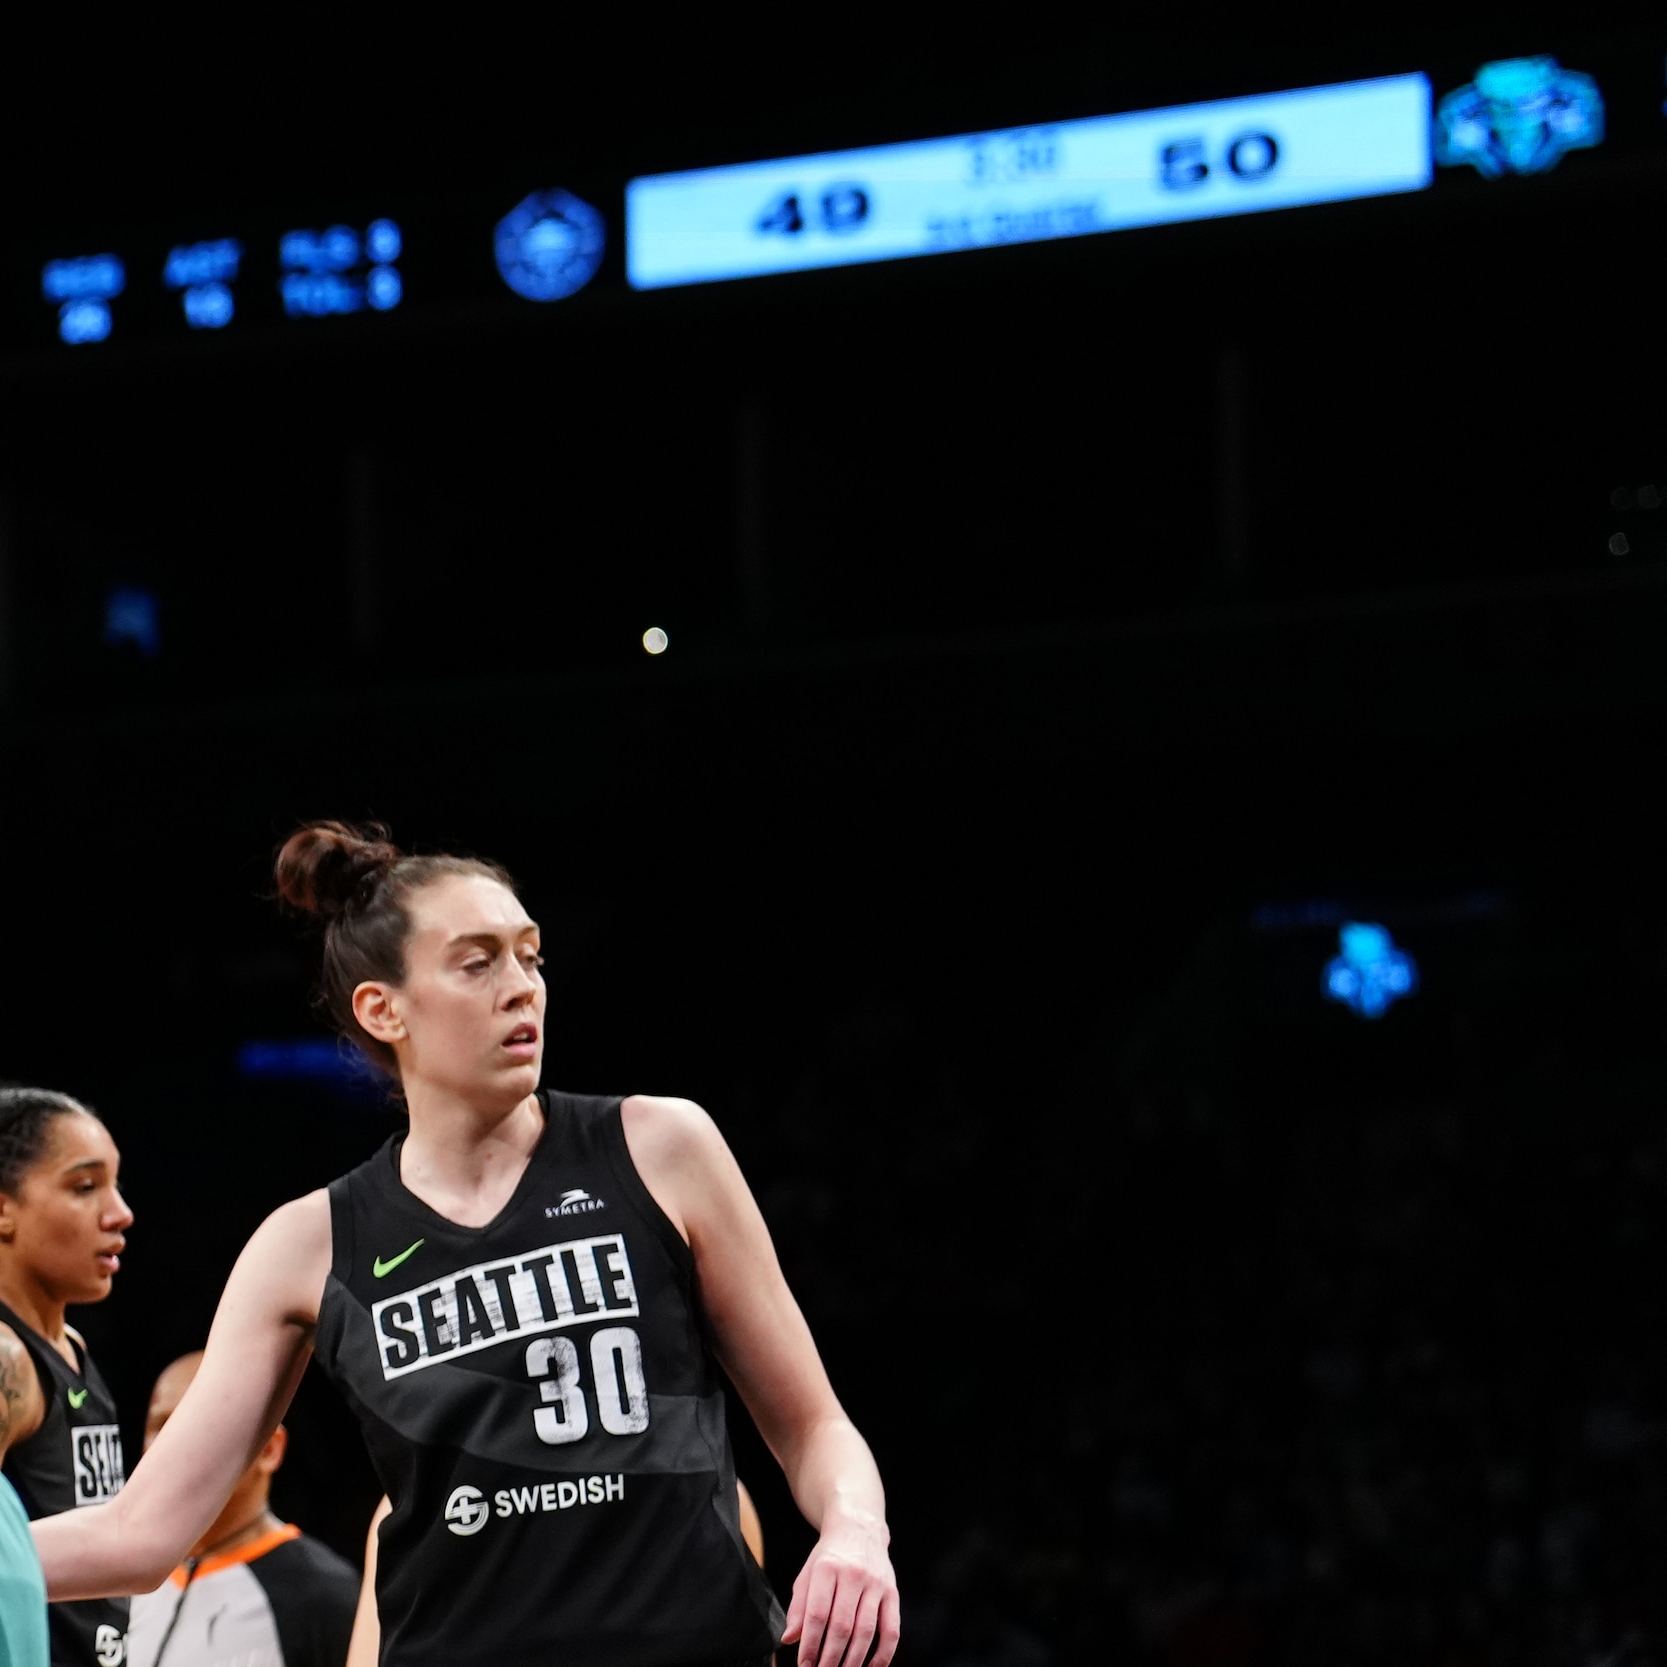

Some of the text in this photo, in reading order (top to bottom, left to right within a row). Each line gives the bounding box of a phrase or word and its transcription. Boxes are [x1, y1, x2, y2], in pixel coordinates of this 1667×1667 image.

[1158, 129, 1282, 196] 50
[545, 1198, 605, 1219] SYMETRA
[380, 1242, 633, 1369] SEATTLE
[525, 1325, 650, 1446] 30
[495, 1473, 625, 1518] SWEDISH
